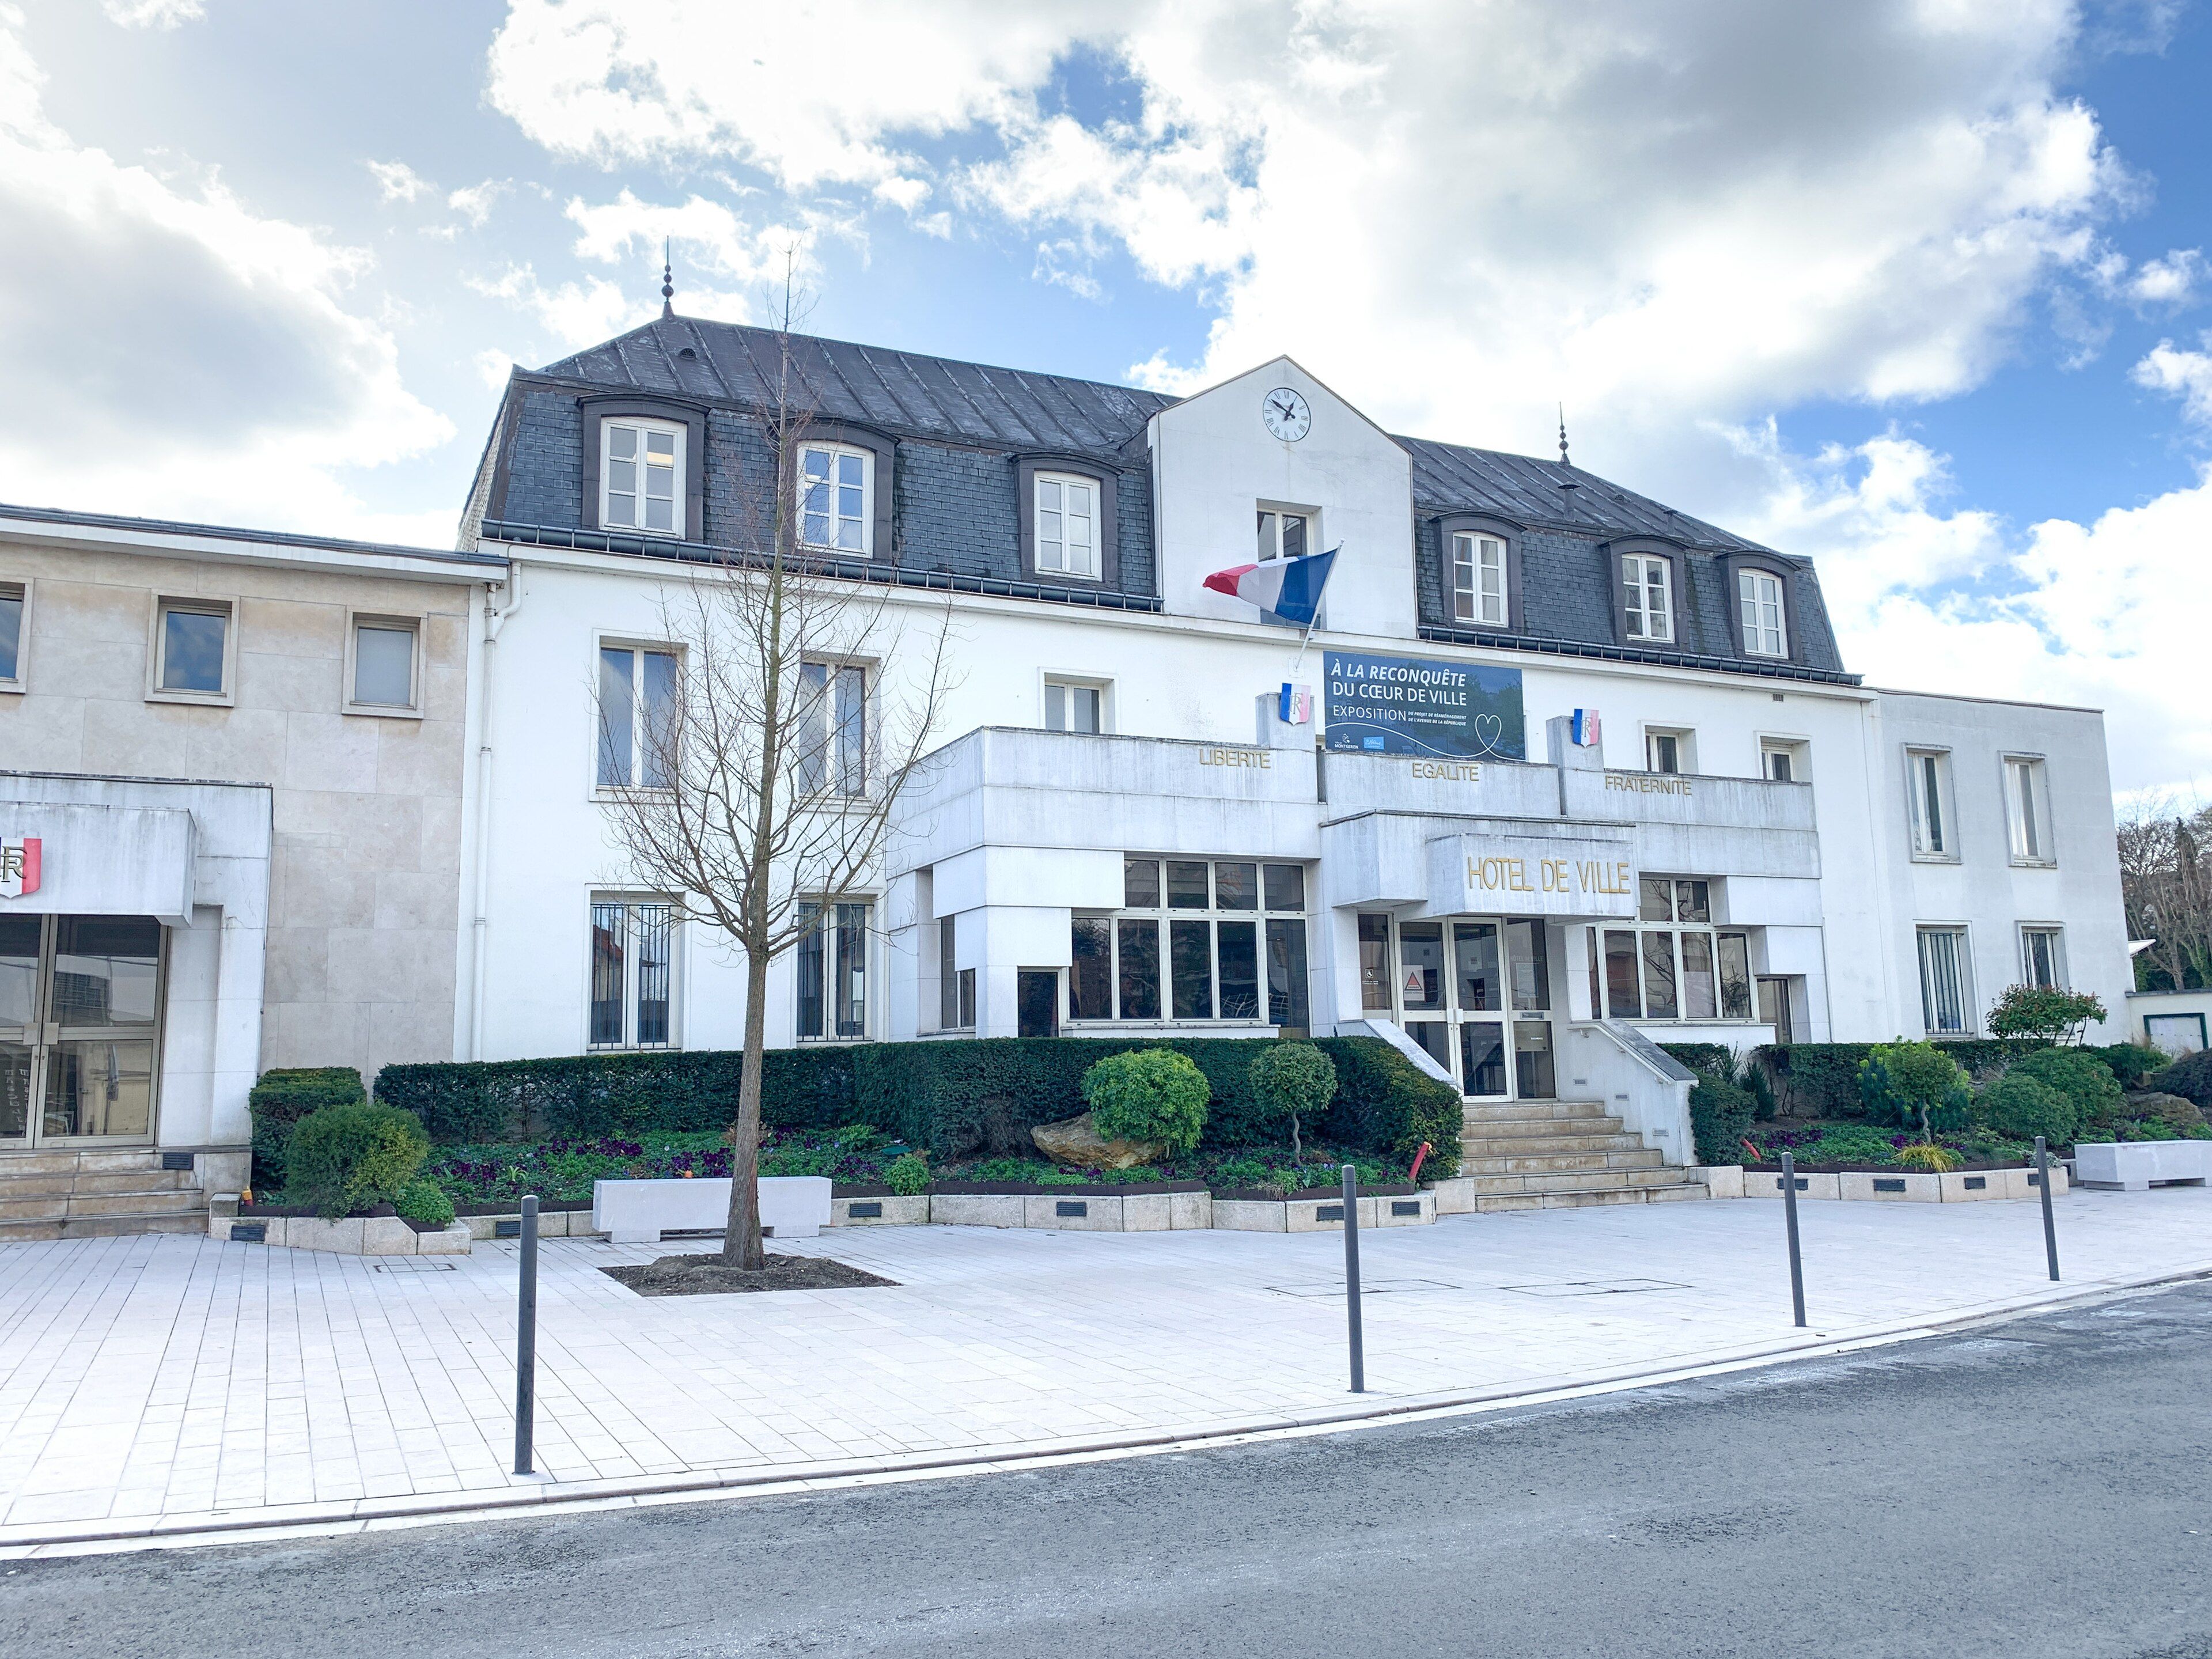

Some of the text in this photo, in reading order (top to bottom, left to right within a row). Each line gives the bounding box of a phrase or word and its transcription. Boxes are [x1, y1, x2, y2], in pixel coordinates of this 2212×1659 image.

[1331, 658, 1467, 687] À LA RECONQUÊTE
[1332, 681, 1467, 706] DU CŒUR DE VILLE
[1333, 704, 1406, 721] EXPOSITION
[1434, 712, 1467, 720] RÉAMÉNAGEMENT
[1199, 748, 1271, 768] LIBERTE
[1412, 762, 1479, 782] EGALITE
[1605, 775, 1692, 796] FRATERNITE
[1468, 857, 1631, 893] HOTEL DE VILLE
